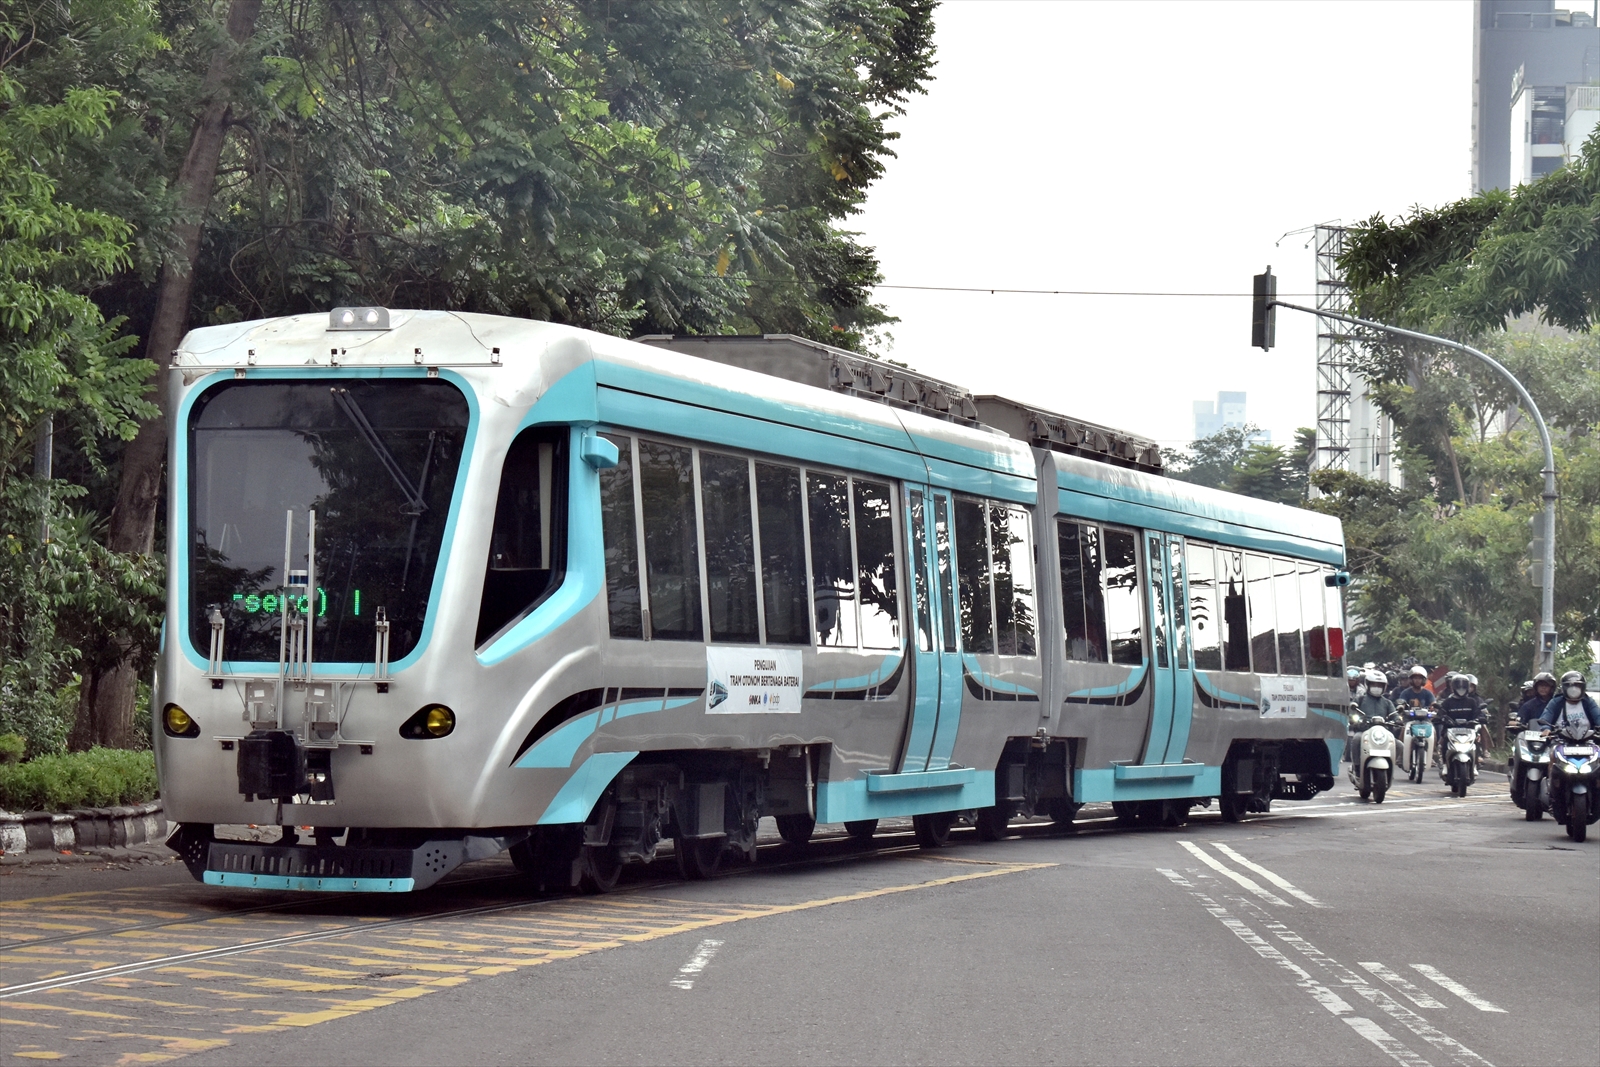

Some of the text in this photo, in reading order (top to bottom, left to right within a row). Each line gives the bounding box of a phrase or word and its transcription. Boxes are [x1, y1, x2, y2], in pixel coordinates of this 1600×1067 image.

[754, 660, 776, 670] PENGUJIAN
[730, 675, 799, 687] TRAM OTONOM BERTENAGA BATERAI
